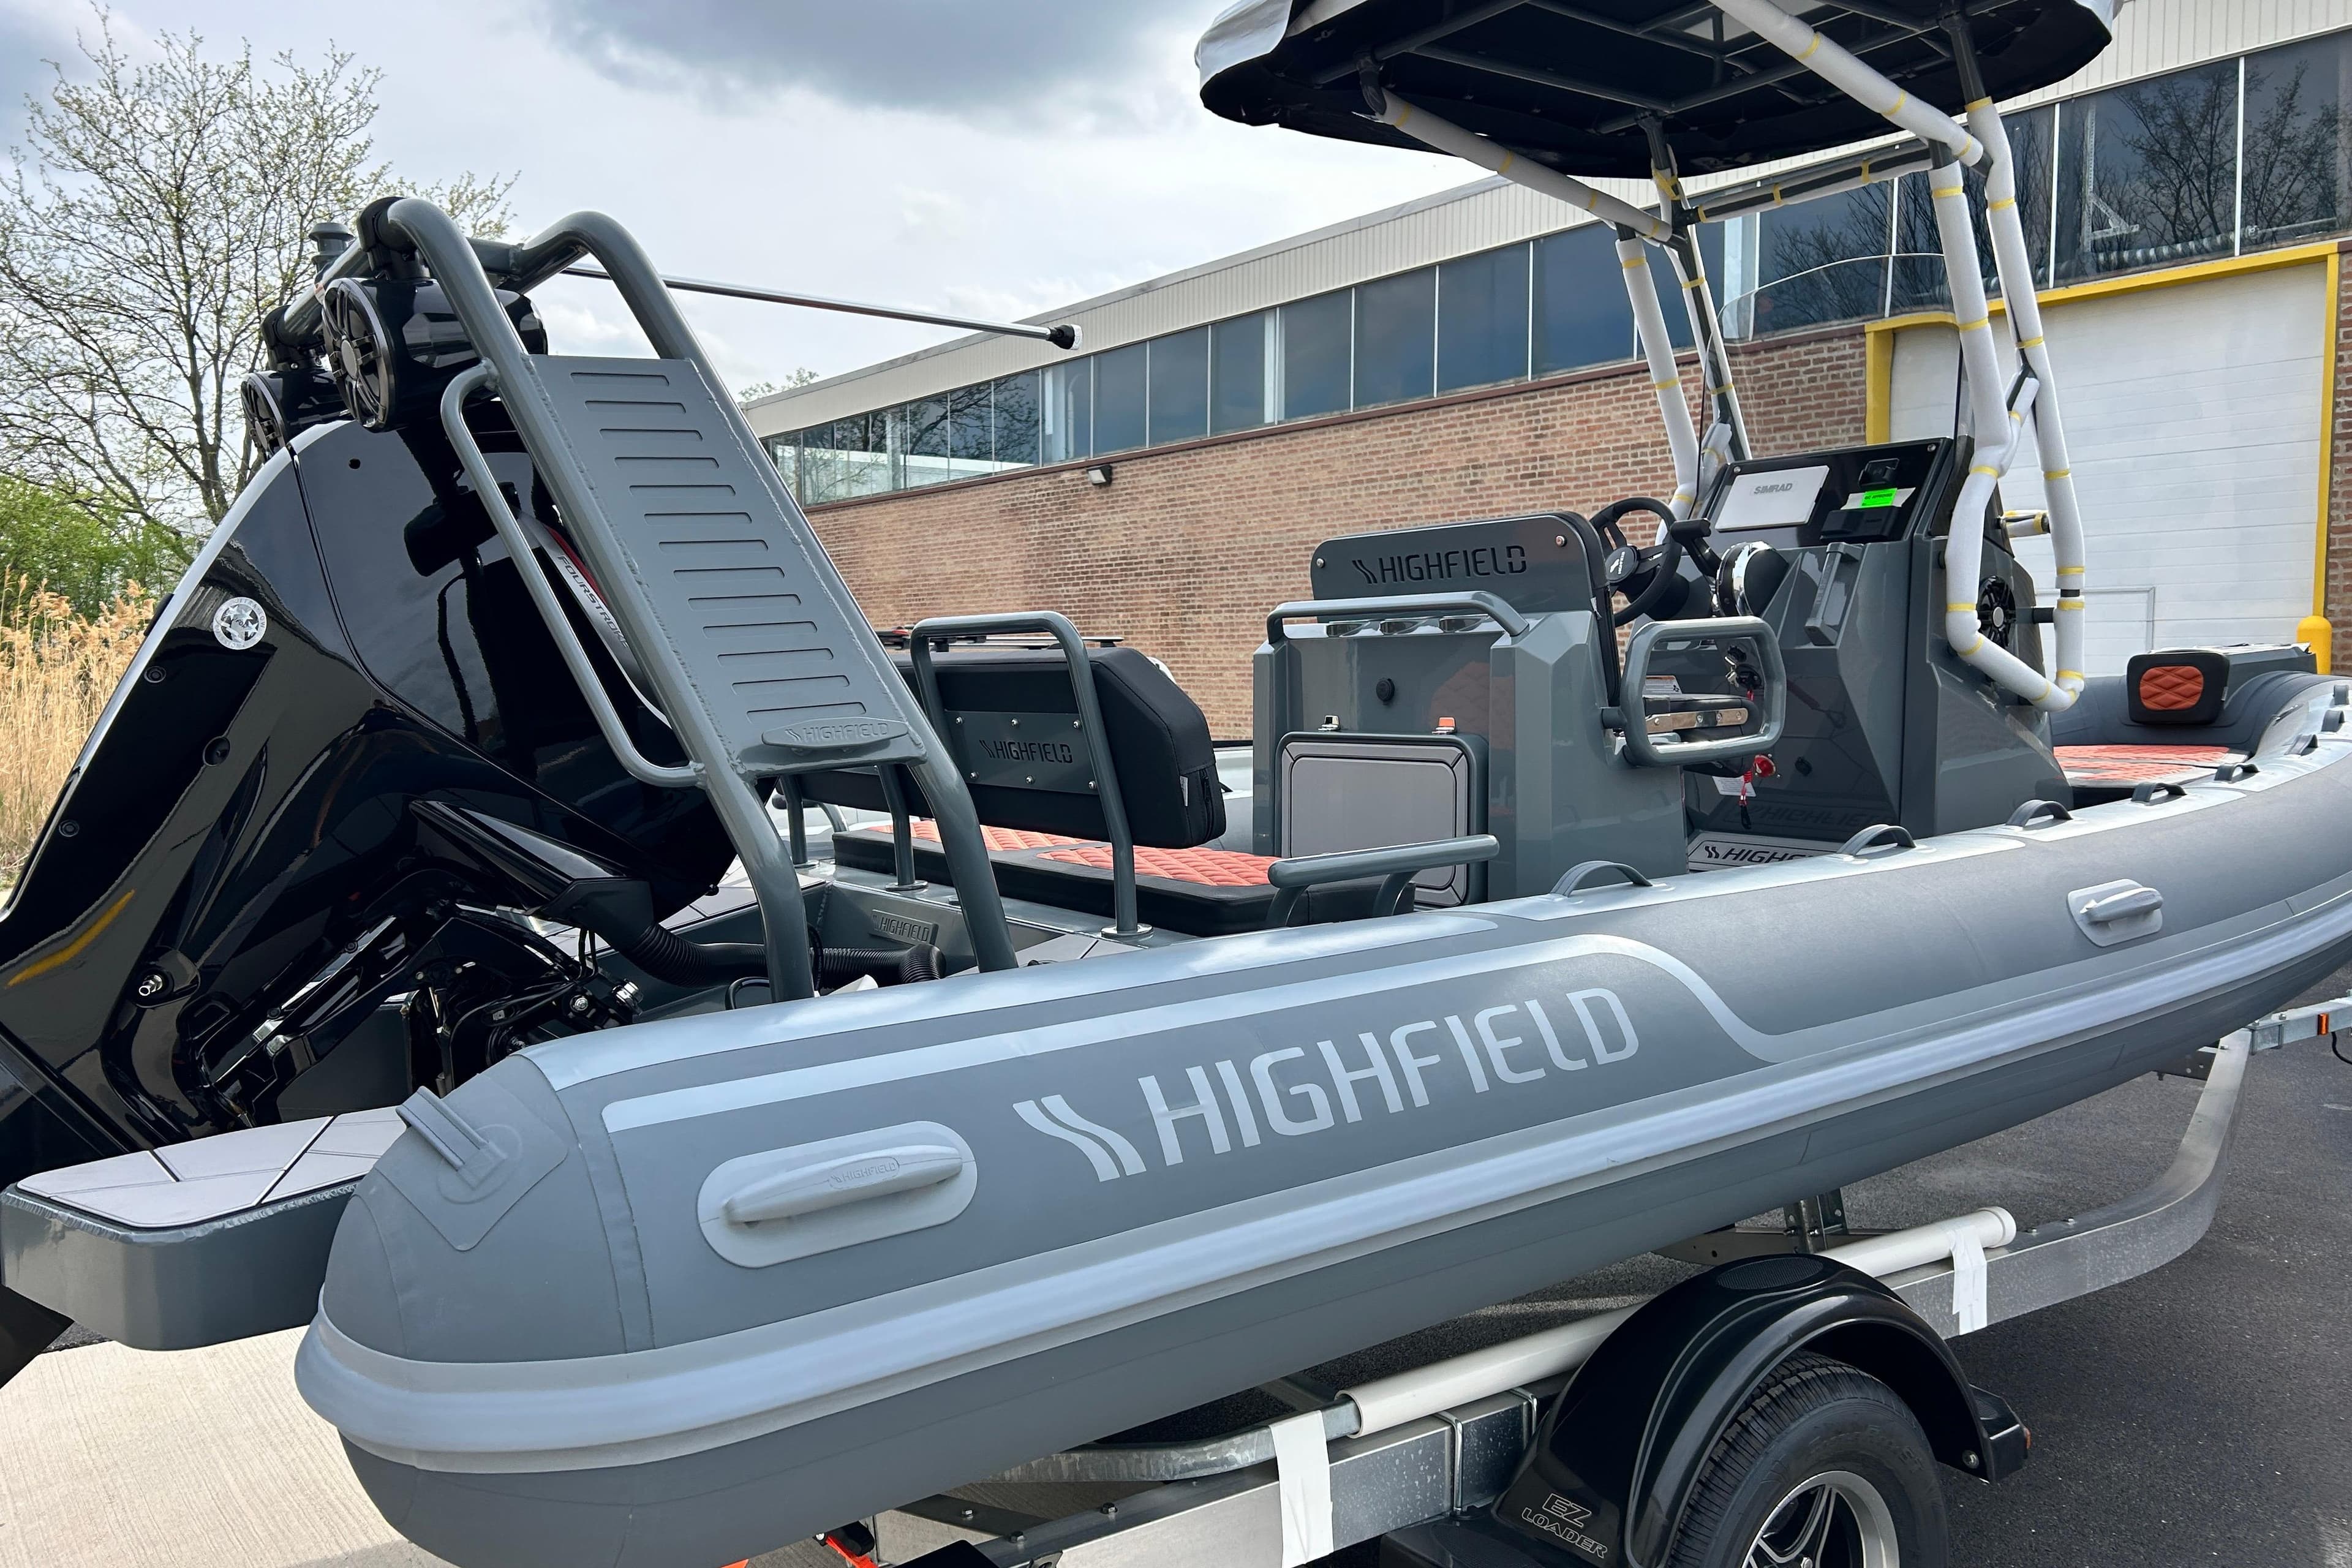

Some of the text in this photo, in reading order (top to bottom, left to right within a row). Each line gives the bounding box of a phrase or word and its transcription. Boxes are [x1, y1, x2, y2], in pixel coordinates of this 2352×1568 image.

[1754, 483, 1793, 494] SIMRAD
[1379, 545, 1527, 583] HIGHFIELD
[557, 555, 630, 648] FOURSTROKE
[802, 722, 889, 742] HIGHFIELD
[993, 740, 1073, 764] HIGHFIELD
[879, 916, 930, 942] HIGHFIELD
[1137, 987, 1640, 1167] HIGHFIELD
[842, 1162, 897, 1182] HIGHFIELD
[1542, 1493, 1593, 1528] EZ
[1521, 1507, 1608, 1559] LOADER
